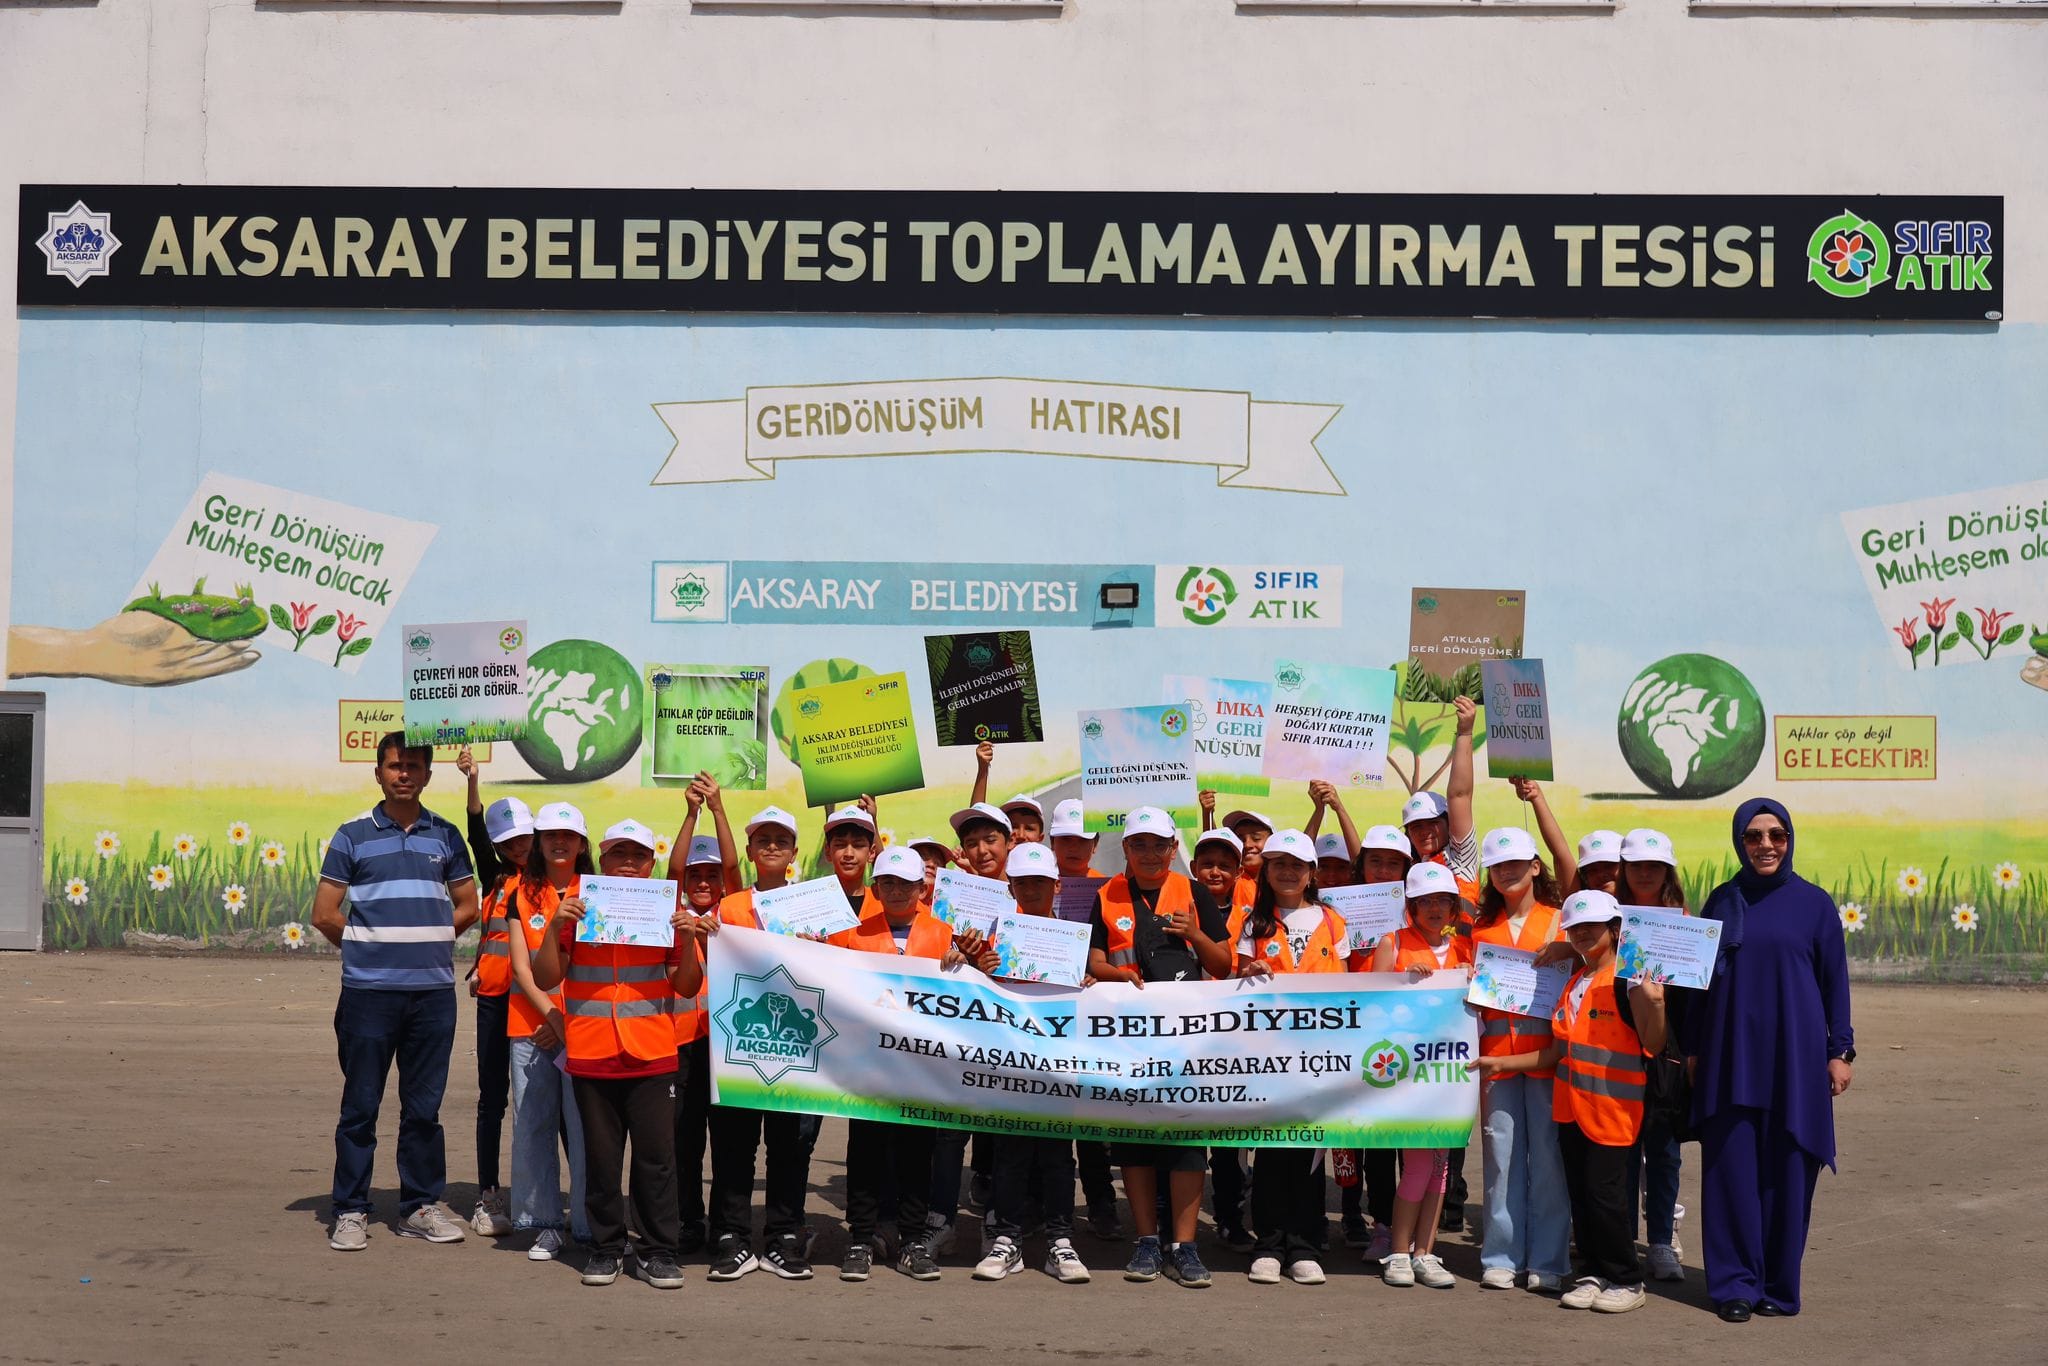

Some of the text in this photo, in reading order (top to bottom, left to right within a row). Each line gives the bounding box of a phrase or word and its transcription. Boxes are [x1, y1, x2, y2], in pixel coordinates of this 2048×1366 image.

[1895, 220, 1992, 254] SIFIR
[56, 252, 100, 260] AKSARAY
[141, 216, 467, 278] AKSARAY
[909, 221, 1245, 284] TOPLAMA
[1258, 223, 1535, 286] AYIRMA
[1895, 255, 1993, 290] ATIK
[1030, 398, 1181, 440] HATIRASI
[204, 494, 385, 567] Geri Dönüşüm
[1861, 520, 1926, 557] Geri
[186, 520, 393, 607] Muhteşem olacak
[1875, 547, 2010, 590] Muhteşem
[1254, 570, 1319, 590] SIFIR
[731, 577, 882, 612] AKSARAY
[1249, 601, 1321, 619] ATIK
[1442, 635, 1490, 644] ATIKLAR
[1411, 645, 1439, 653] GERİ
[1444, 645, 1513, 657] DÖNÜŞÜME
[413, 663, 520, 684] ÇEVREYİ HOR GÖREN,
[939, 662, 1028, 701] İLERİYİ DÜŞÜNELİM
[410, 683, 458, 700] GELECEĞİ
[461, 685, 481, 698] ZOR
[878, 681, 898, 691] SIFIR
[947, 678, 1028, 712] GERİ KAZANALIM
[1513, 680, 1541, 698] İMKA
[657, 707, 754, 722] ATIKLAR ÇÖP DEĞİLDİR
[1274, 703, 1387, 725] HERŞEYİ ÇÖPE ATMA
[1515, 702, 1542, 719] GERİ
[437, 727, 466, 738] SIFIR
[802, 716, 909, 745] AKSARAY BELEDİYESİ
[1216, 721, 1263, 738] GERİ
[1284, 717, 1375, 737] DOĞAYI KURTAR
[1490, 721, 1545, 742] DÖNÜŞÜM
[1834, 728, 1857, 743] çöp
[1863, 726, 1893, 744] değil
[817, 742, 840, 755] İKLİM
[886, 734, 897, 742] VE
[1281, 732, 1312, 745] SIFIR
[1312, 735, 1353, 750] ATIKLA
[815, 755, 835, 766] SIFIR
[835, 753, 853, 762] ATIK
[1088, 761, 1141, 775] GELECEĞİNİ
[1086, 775, 1107, 786] GERİ
[1106, 814, 1127, 827] SIF
[874, 988, 1361, 1038] AKSARAY BELEDİYESİ
[736, 1038, 810, 1058] AKSARAY
[879, 1032, 952, 1059] DAHA
[1129, 1057, 1174, 1078] BİR
[1180, 1055, 1292, 1076] AKSARAY
[1298, 1050, 1352, 1078] İÇİN
[1413, 1041, 1470, 1062] SIFIR
[1413, 1062, 1471, 1084] ATIK
[961, 1071, 1267, 1106] SIFIRDAN BAŞLIYORUZ...
[900, 1103, 1325, 1143] İKLİM DEĞİŞİKLİĞİ VE SIFIR ATIK MÜDÜRLÜĞÜ
